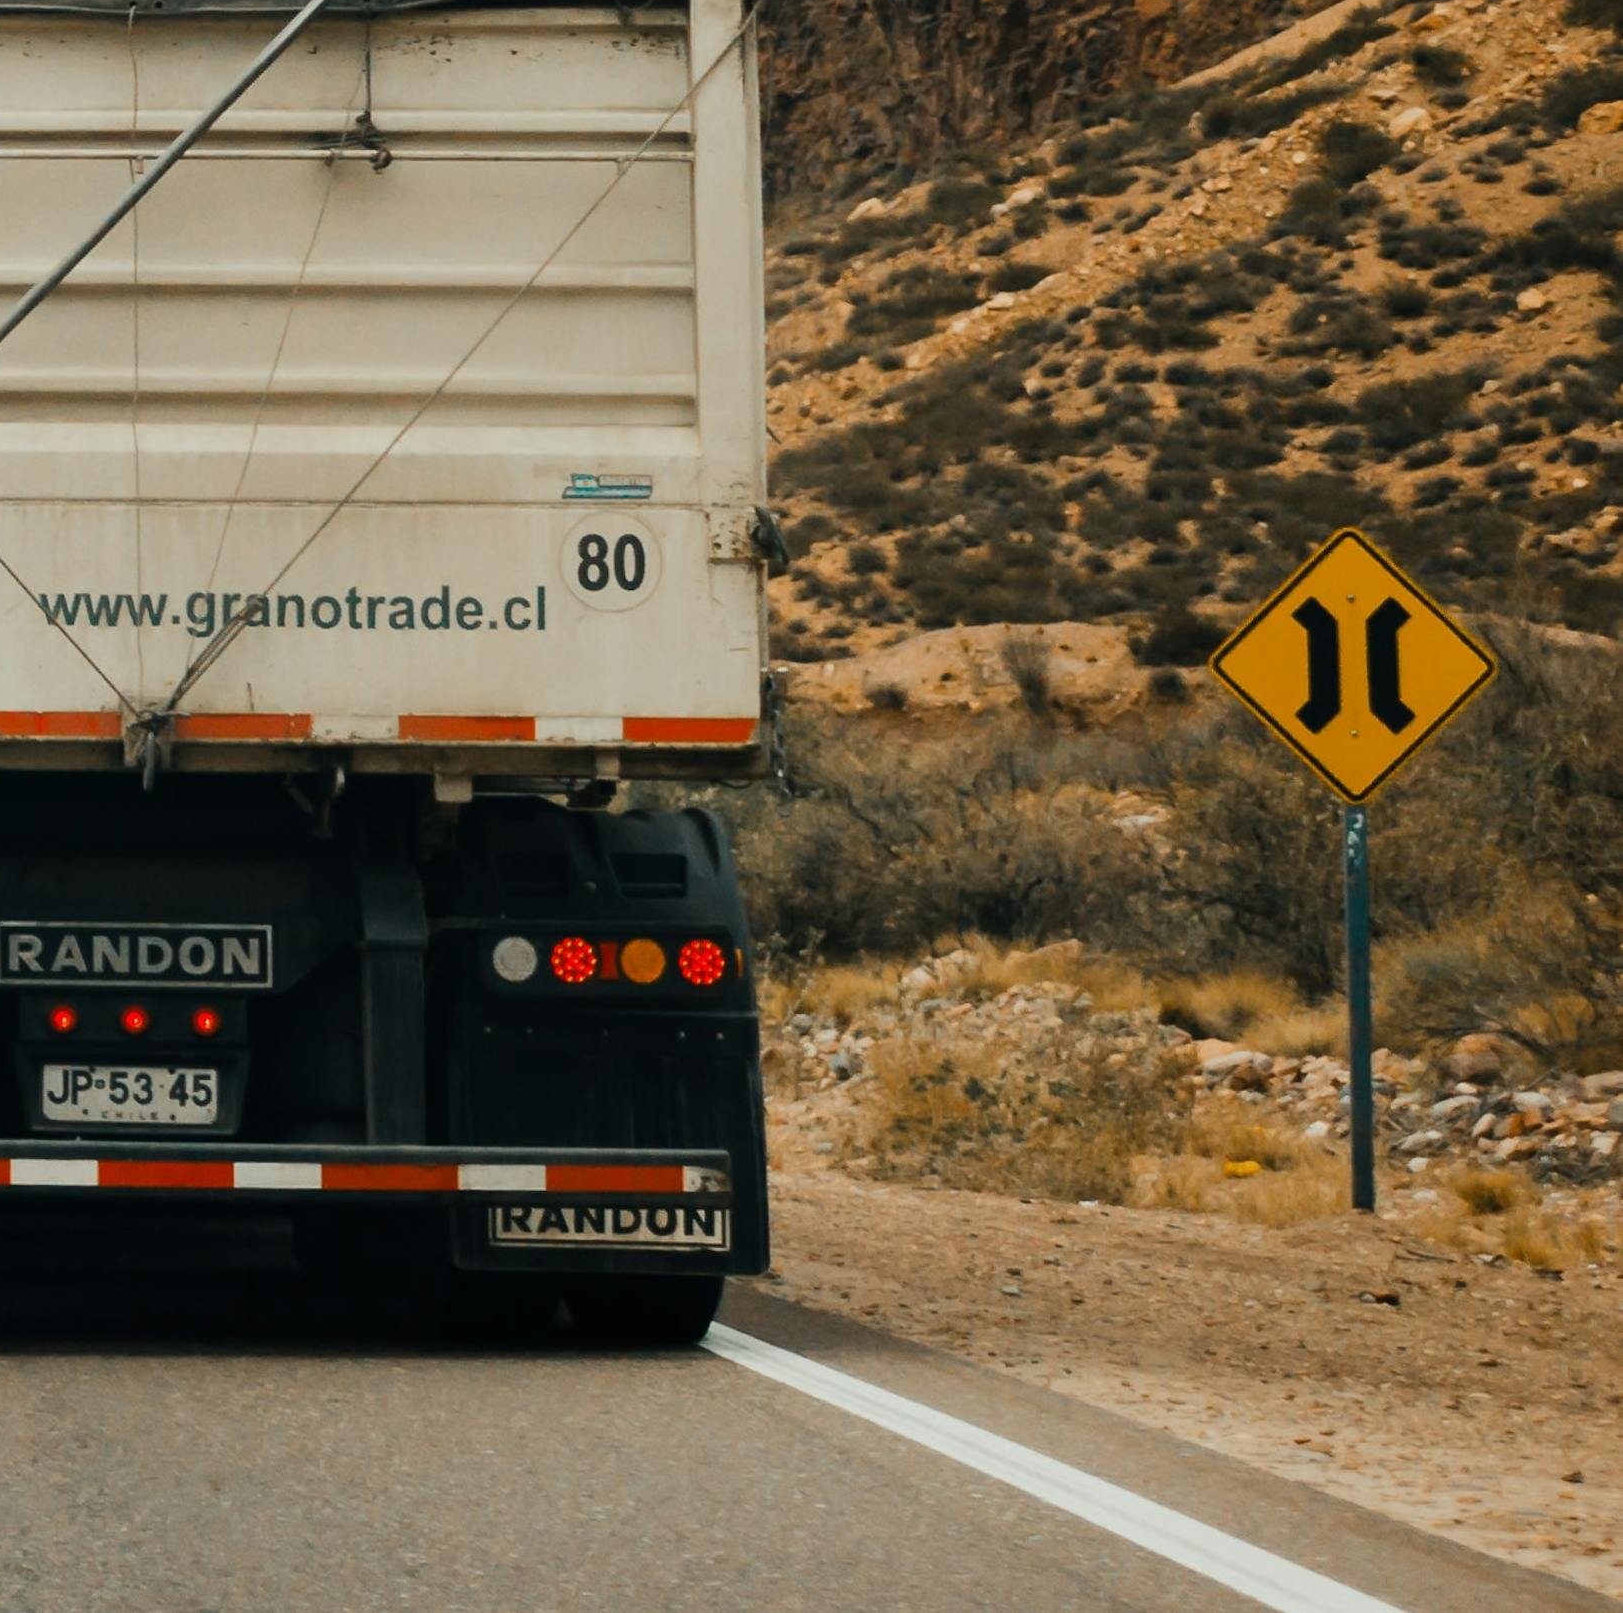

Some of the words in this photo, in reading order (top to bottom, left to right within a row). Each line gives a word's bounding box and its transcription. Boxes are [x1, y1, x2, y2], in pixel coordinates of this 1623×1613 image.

[576, 533, 647, 591] 80
[39, 585, 547, 638] www.granotrade.cl
[8, 934, 260, 976] RANDON
[501, 1206, 717, 1237] RANDON
